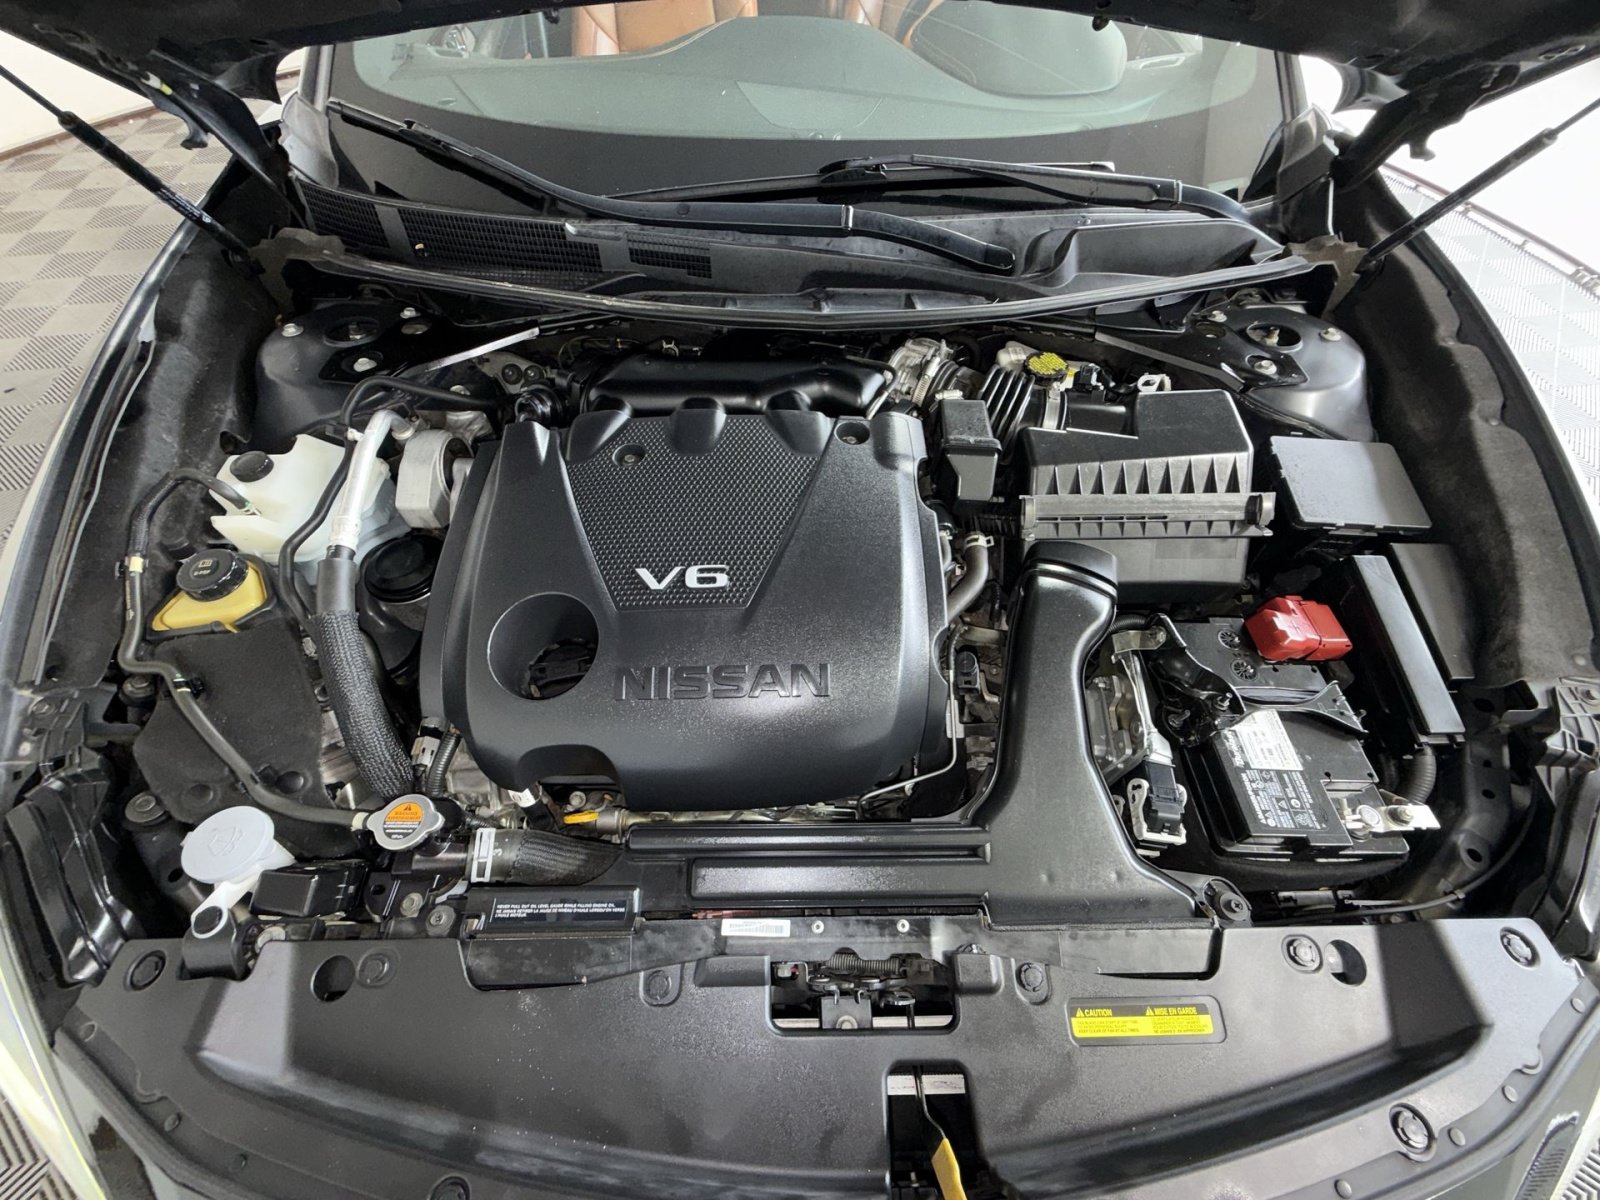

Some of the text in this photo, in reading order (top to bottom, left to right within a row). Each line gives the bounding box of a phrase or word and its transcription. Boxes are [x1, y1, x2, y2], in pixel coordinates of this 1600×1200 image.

[635, 564, 730, 590] V6
[615, 663, 830, 700] NISSAN
[1084, 1008, 1113, 1017] CAUTION
[1154, 1006, 1198, 1016] MISE EN GARDE
